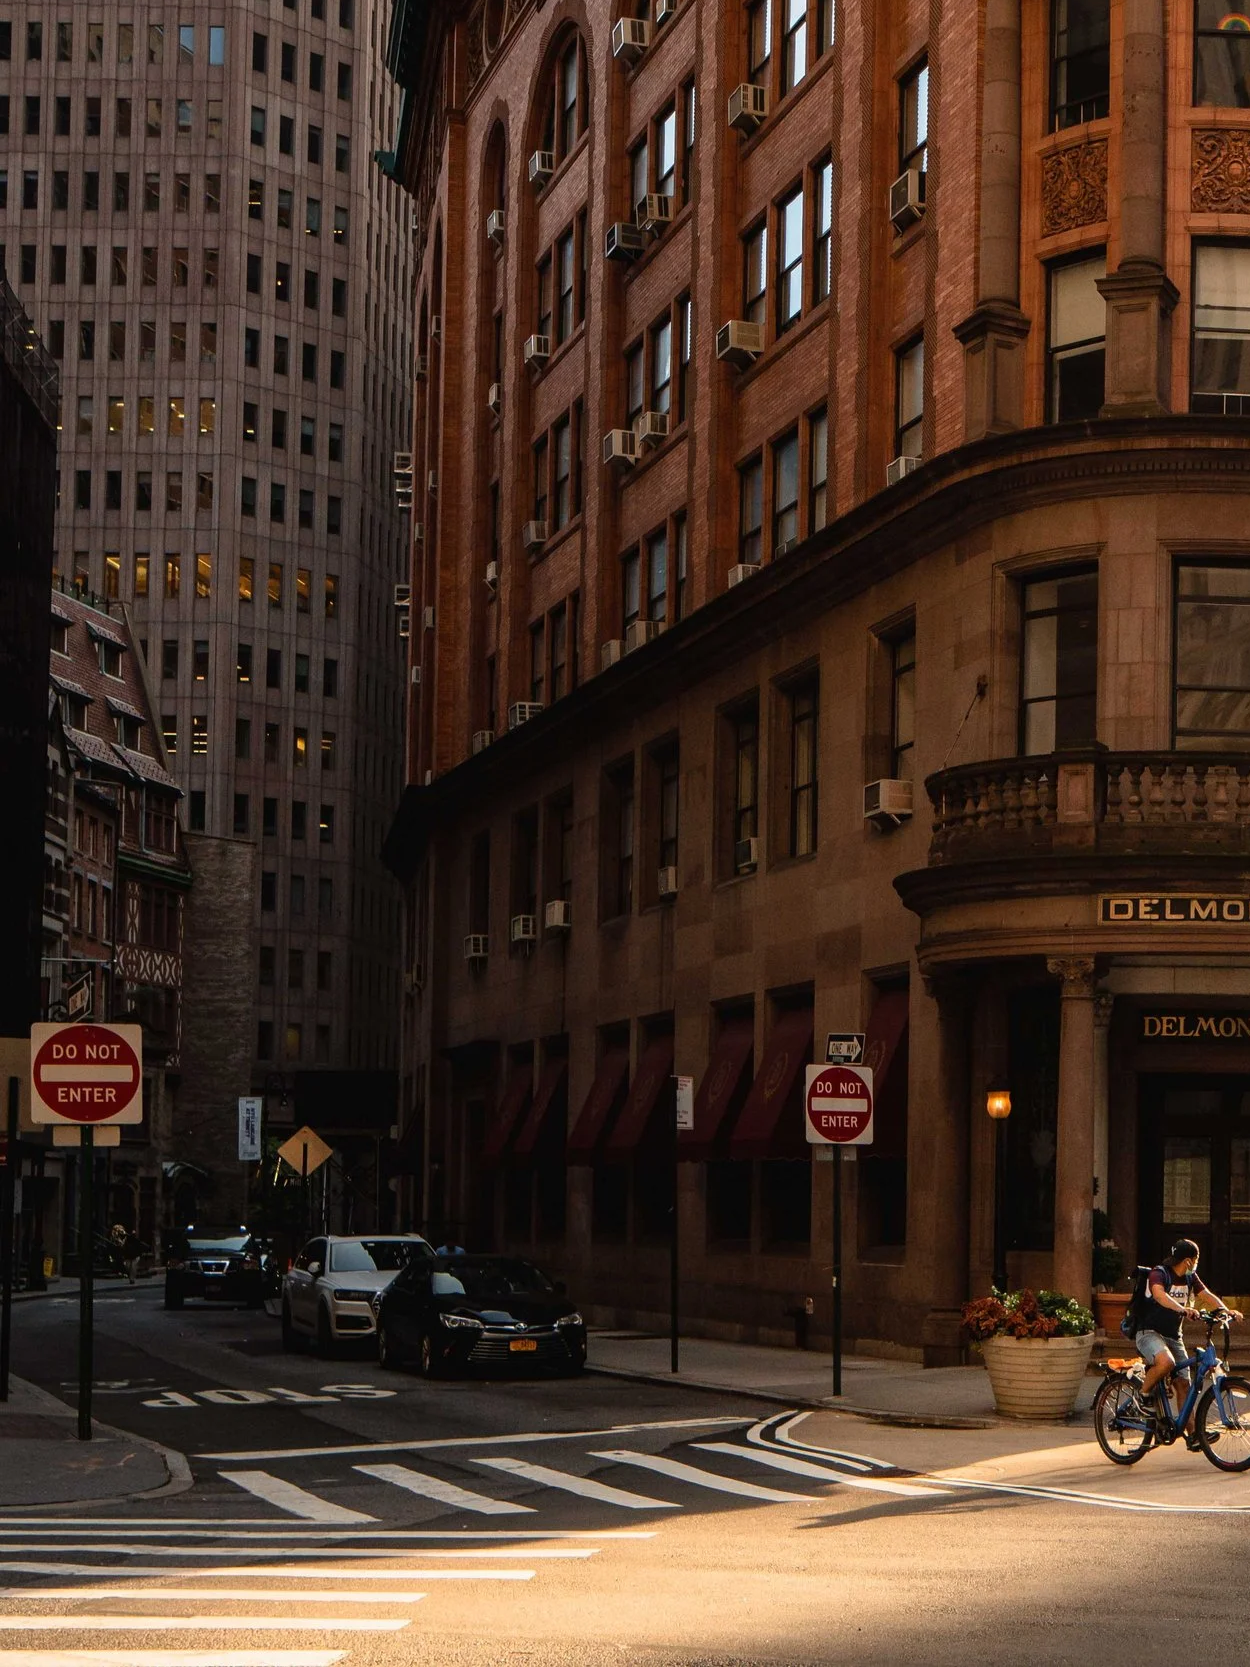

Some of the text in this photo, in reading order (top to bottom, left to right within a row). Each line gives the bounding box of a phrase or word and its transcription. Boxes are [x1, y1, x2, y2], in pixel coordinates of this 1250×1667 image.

[52, 1043, 120, 1060] DO NOT
[831, 1042, 859, 1055] ONE WAY
[57, 1087, 117, 1103] ENTER
[816, 1081, 862, 1095] DO NOT
[821, 1115, 858, 1128] ENTER
[140, 1383, 399, 1408] STOP
